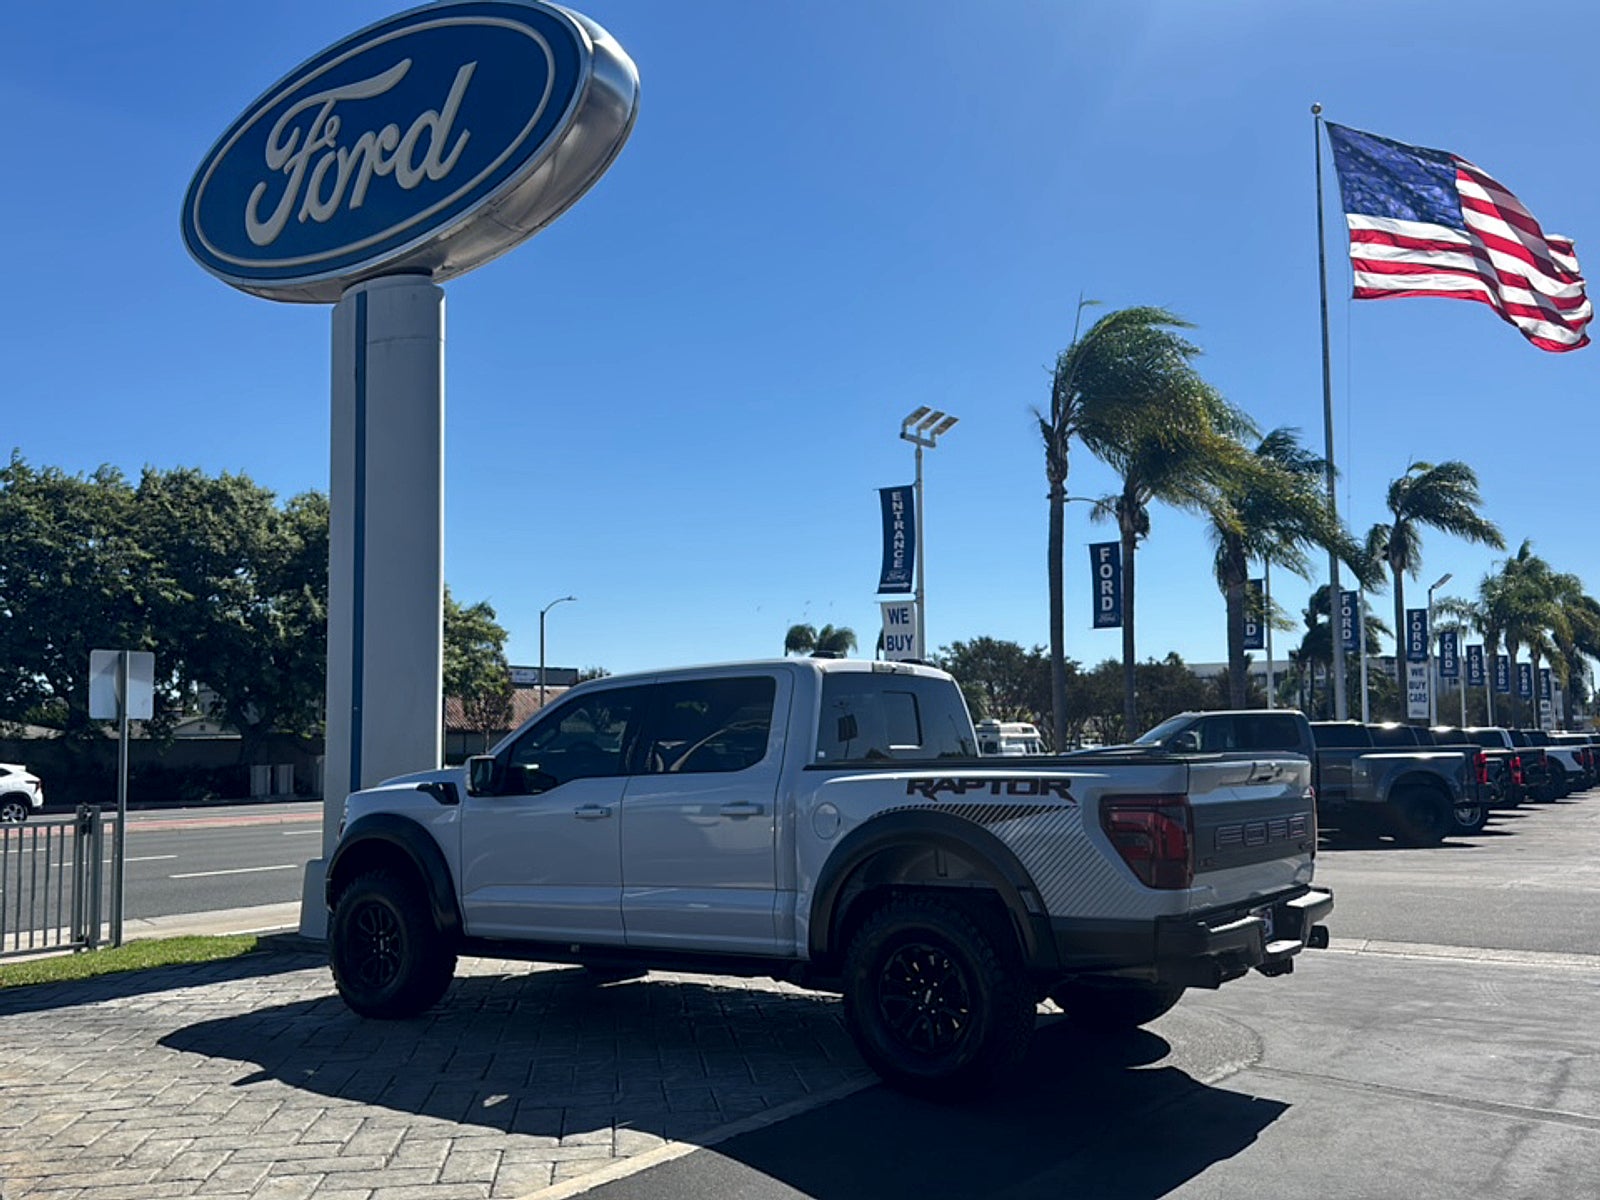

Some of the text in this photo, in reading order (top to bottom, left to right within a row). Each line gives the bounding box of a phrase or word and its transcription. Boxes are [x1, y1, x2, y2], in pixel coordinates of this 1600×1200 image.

[245, 58, 477, 246] Ford
[892, 491, 905, 568] ENTRANCE
[1100, 547, 1114, 612] FORD
[887, 608, 910, 625] WE
[1341, 595, 1353, 640] FORD
[1411, 612, 1422, 652] FORD
[886, 634, 913, 651] BUY
[1444, 633, 1454, 669] FORD
[1410, 668, 1425, 677] WE
[1471, 647, 1480, 679] FORD
[1408, 681, 1427, 691] BUY
[1409, 693, 1428, 703] CARS
[906, 777, 1079, 805] RAPTOR
[1214, 815, 1307, 850] FORD
